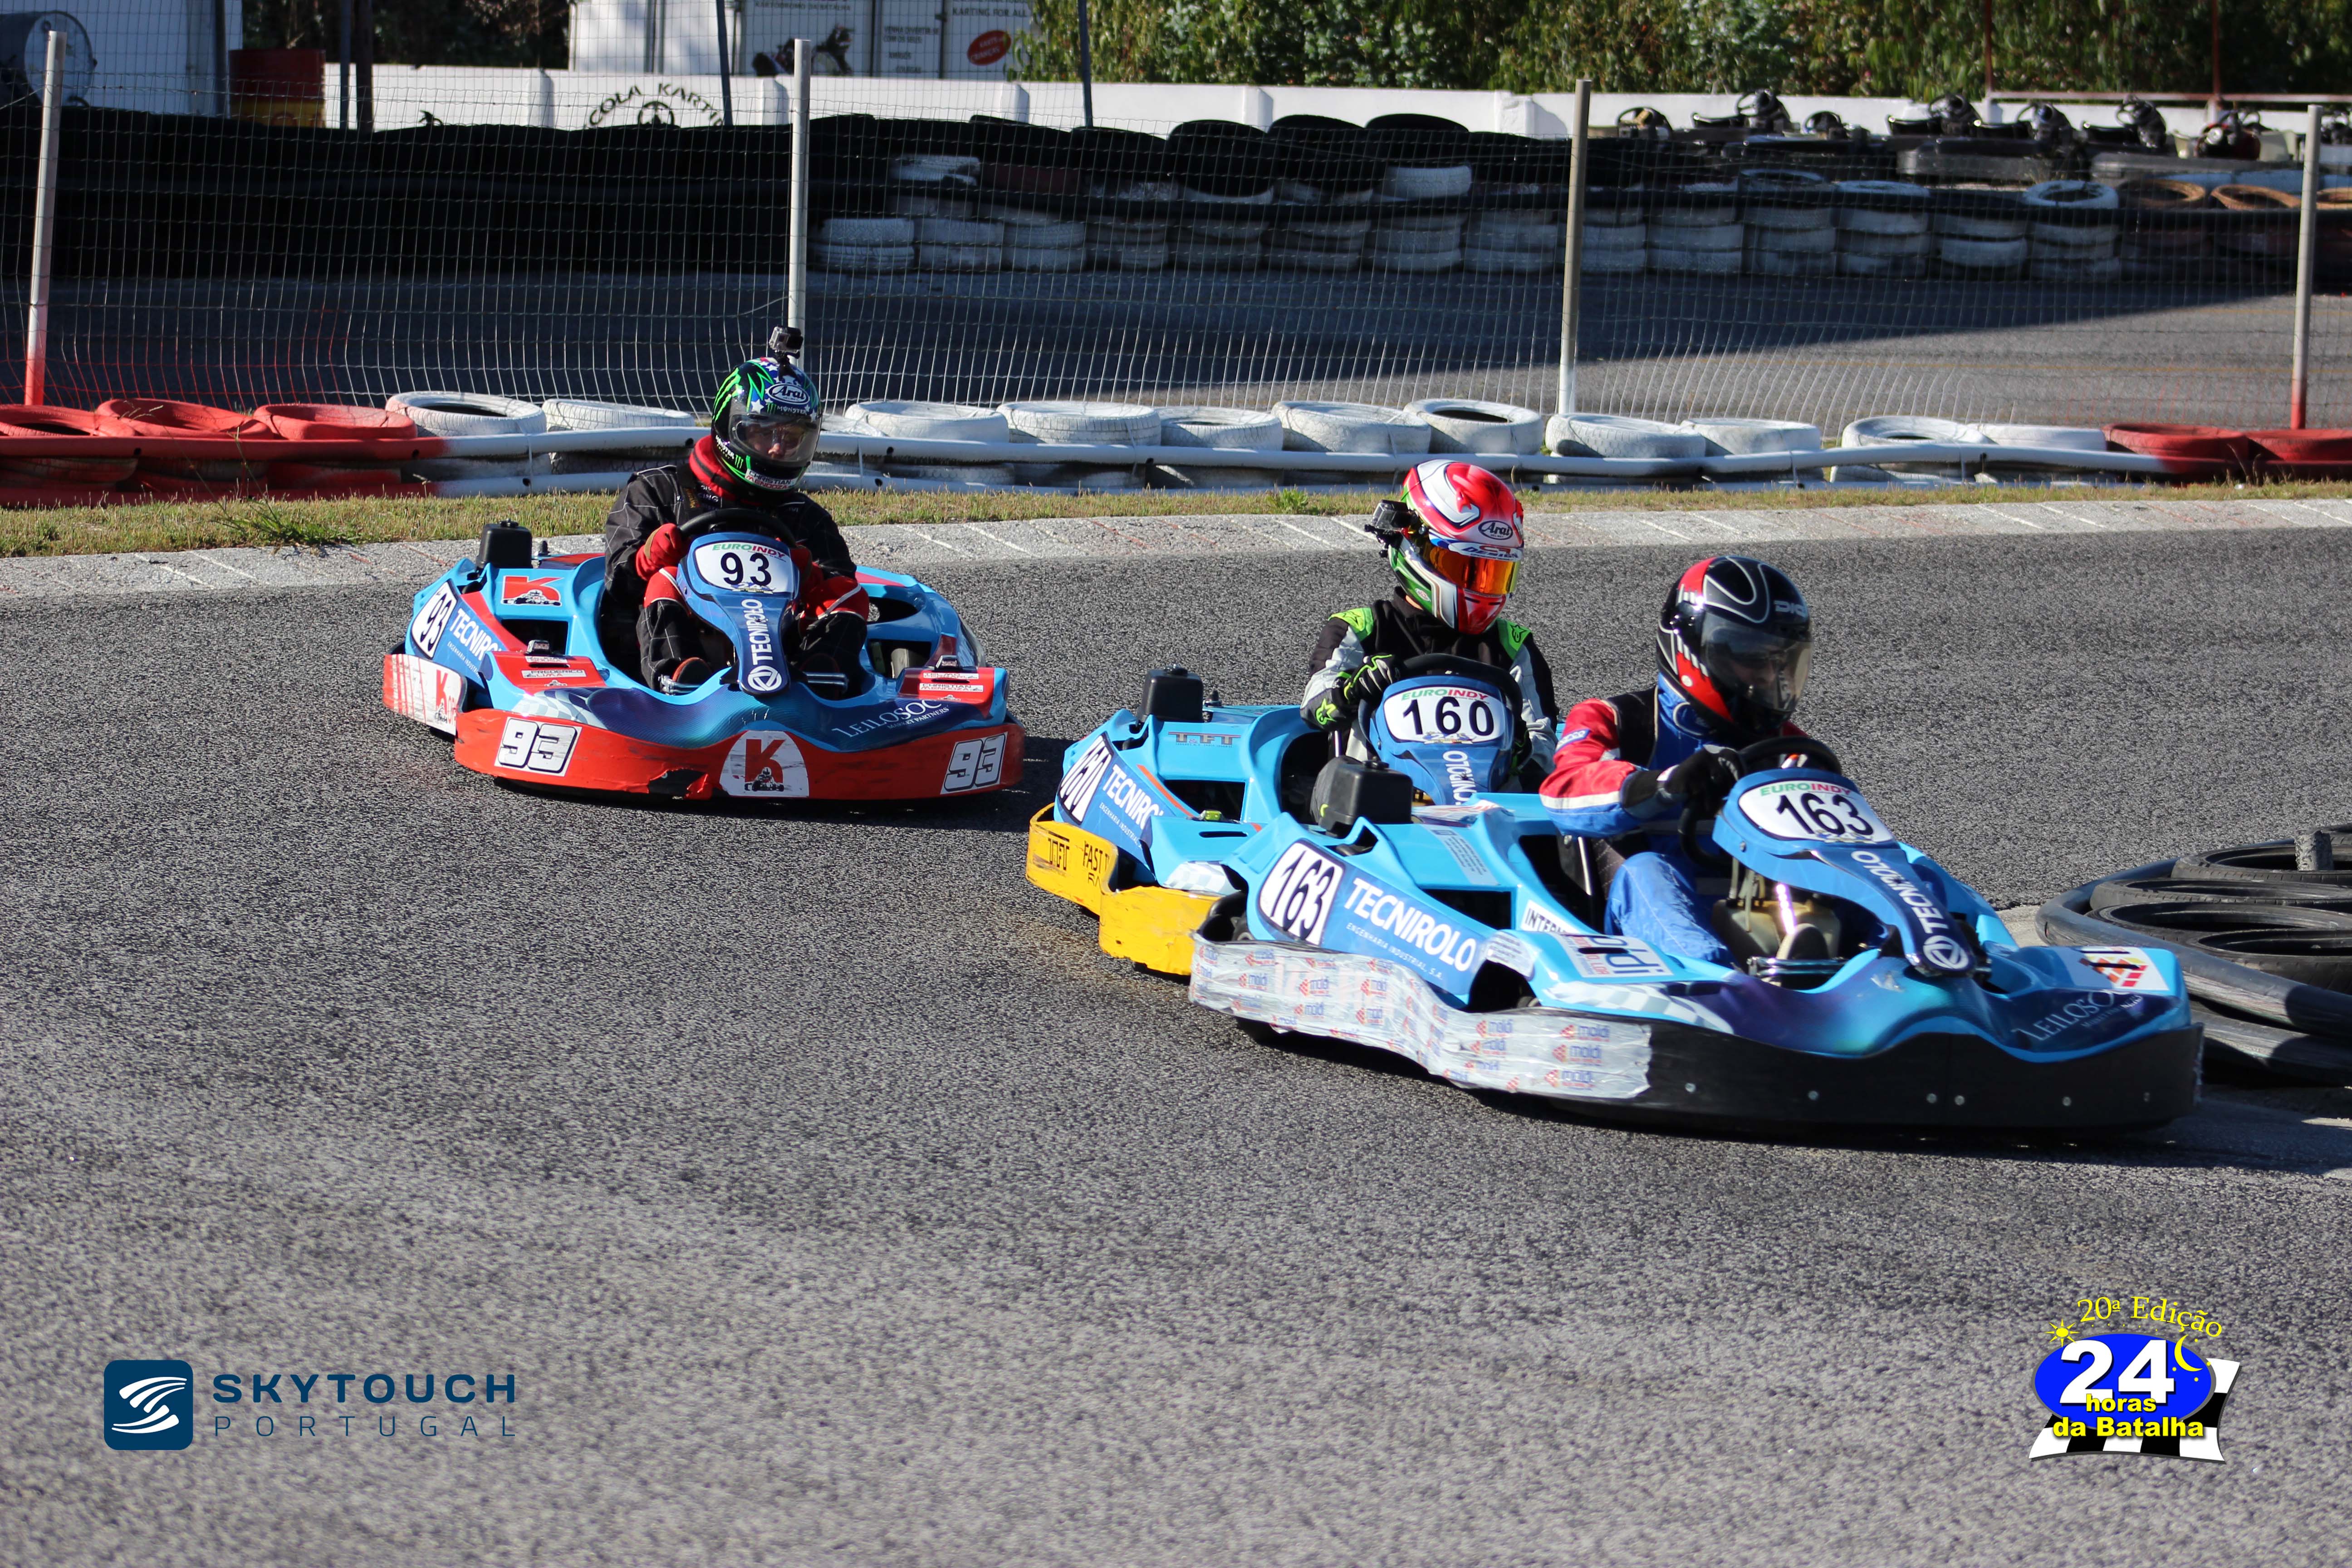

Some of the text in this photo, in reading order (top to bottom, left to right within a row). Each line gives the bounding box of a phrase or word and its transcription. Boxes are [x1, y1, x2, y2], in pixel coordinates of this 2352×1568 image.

[952, 7, 1027, 17] KARTING FOR ALL
[772, 386, 805, 399] Arai
[746, 475, 789, 490] MENDOZA
[749, 470, 792, 485] CHRISTIAN
[1481, 522, 1510, 536] Arai
[712, 543, 786, 559] EUROINDY
[1461, 546, 1519, 559] DESIGN
[720, 552, 772, 587] 93
[420, 593, 453, 652] 93
[741, 598, 774, 666] TECNIROLO
[447, 641, 466, 662] ENGENHARIA
[1401, 689, 1489, 701] EUROINDY
[914, 706, 949, 724] PARTNERS
[1403, 696, 1494, 736] 160
[498, 718, 578, 773] 93
[945, 733, 1006, 792] 93
[1760, 783, 1852, 796] EUROINDY
[1099, 802, 1121, 826] ENGENHARIA
[1776, 793, 1874, 836] 163
[1082, 840, 1103, 874] FAST
[1270, 850, 1335, 941] 163
[1851, 850, 1949, 934] TECNIROLO
[1344, 877, 1477, 972] TECNIROLO
[1346, 922, 1389, 950] ENGENHARIA
[1388, 945, 1427, 972] INDUSTRIAL,
